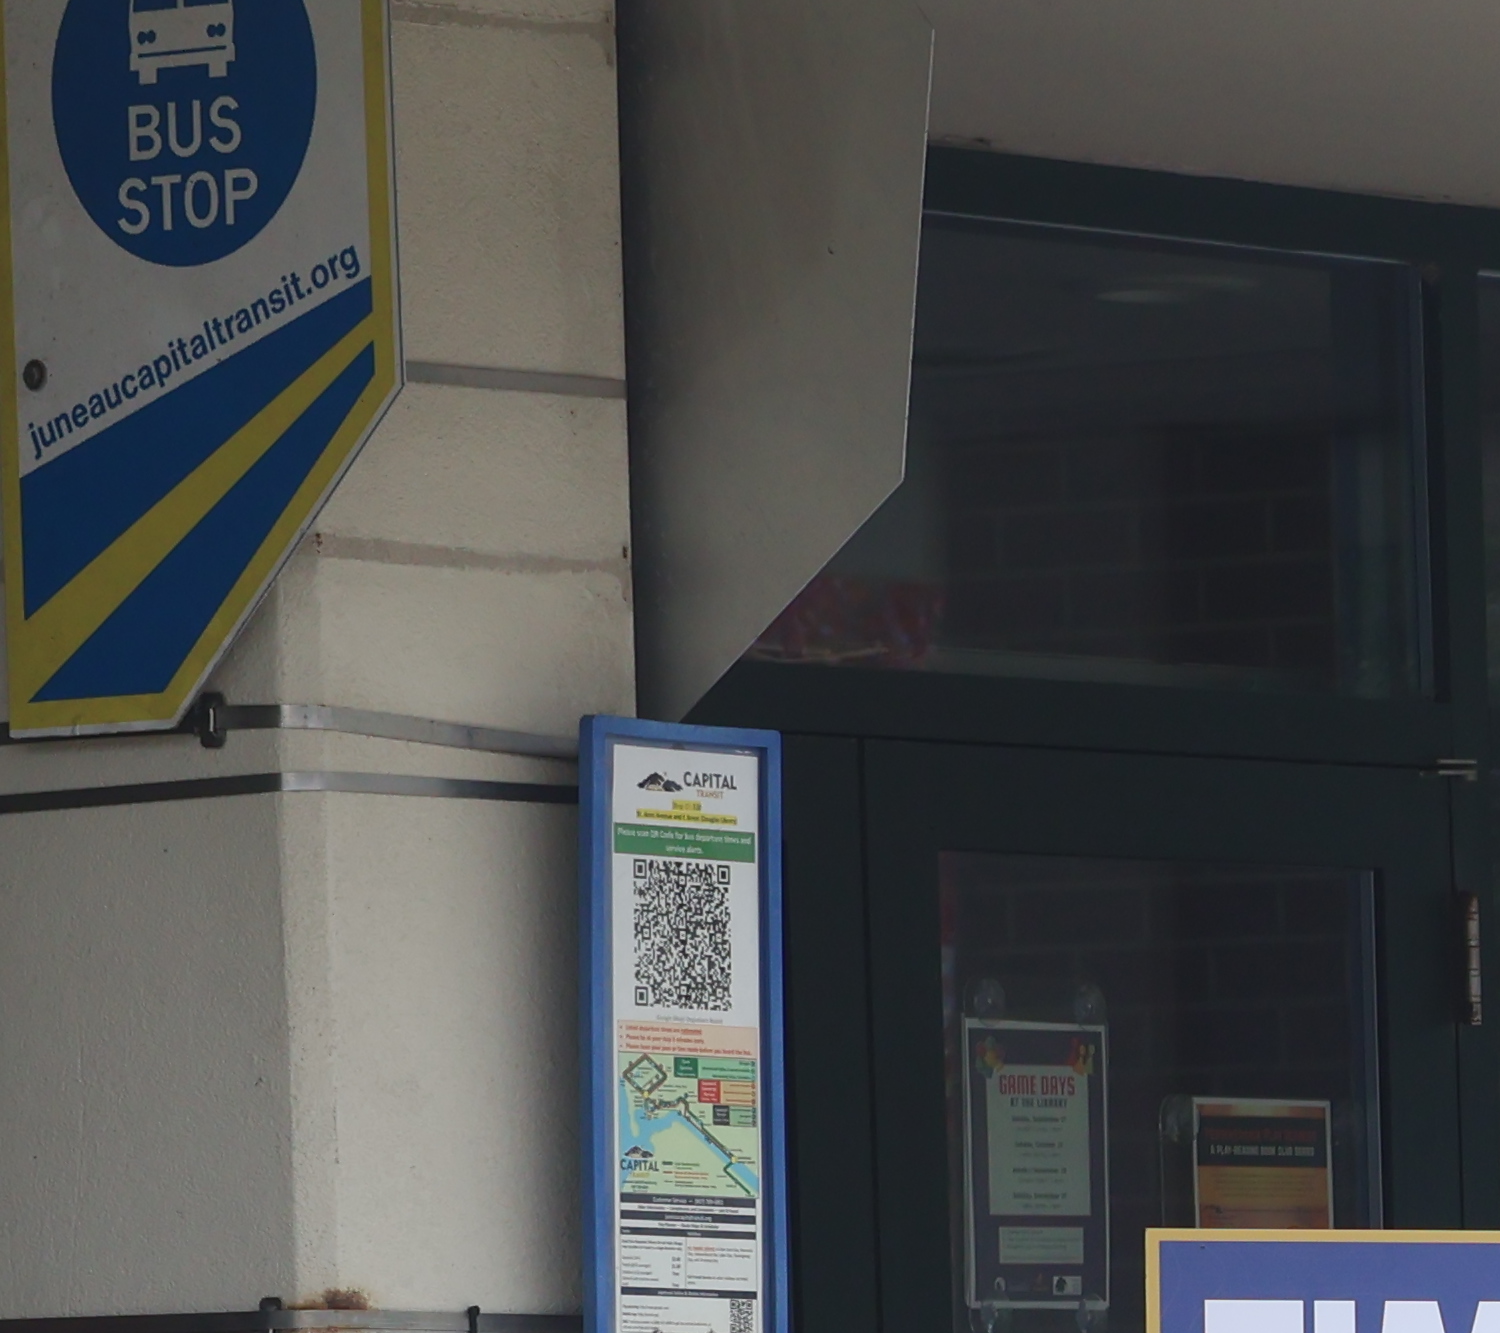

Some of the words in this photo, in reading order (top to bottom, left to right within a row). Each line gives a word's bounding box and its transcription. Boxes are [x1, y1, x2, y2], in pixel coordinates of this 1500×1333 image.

[128, 94, 241, 161] BUS
[117, 168, 258, 235] STOP
[28, 243, 361, 459] juneaucapitaltransit.org
[683, 771, 737, 790] CAPITAL
[1000, 1075, 1036, 1095] GAME
[1041, 1076, 1075, 1096] DAYS
[620, 1159, 659, 1172] CAPITAL
